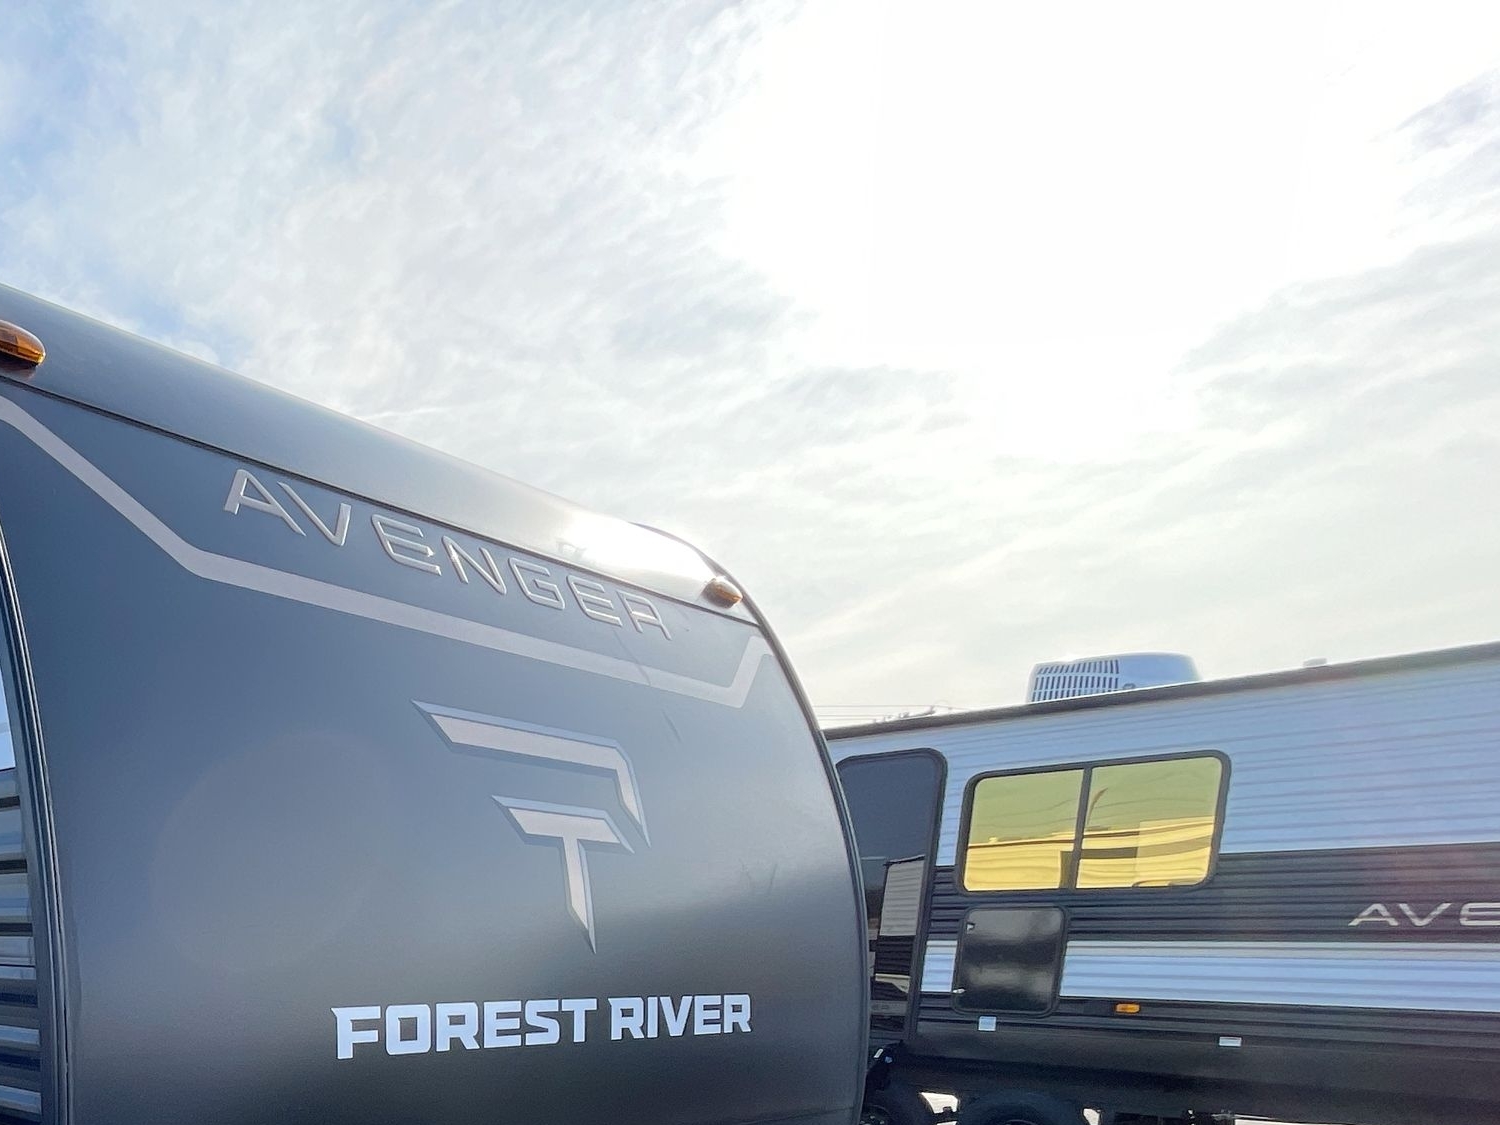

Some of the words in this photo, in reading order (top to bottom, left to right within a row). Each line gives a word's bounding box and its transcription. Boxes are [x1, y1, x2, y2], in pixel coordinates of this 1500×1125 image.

[224, 468, 672, 640] AVENGER
[331, 998, 598, 1060] FOREST
[607, 994, 752, 1041] RIVER
